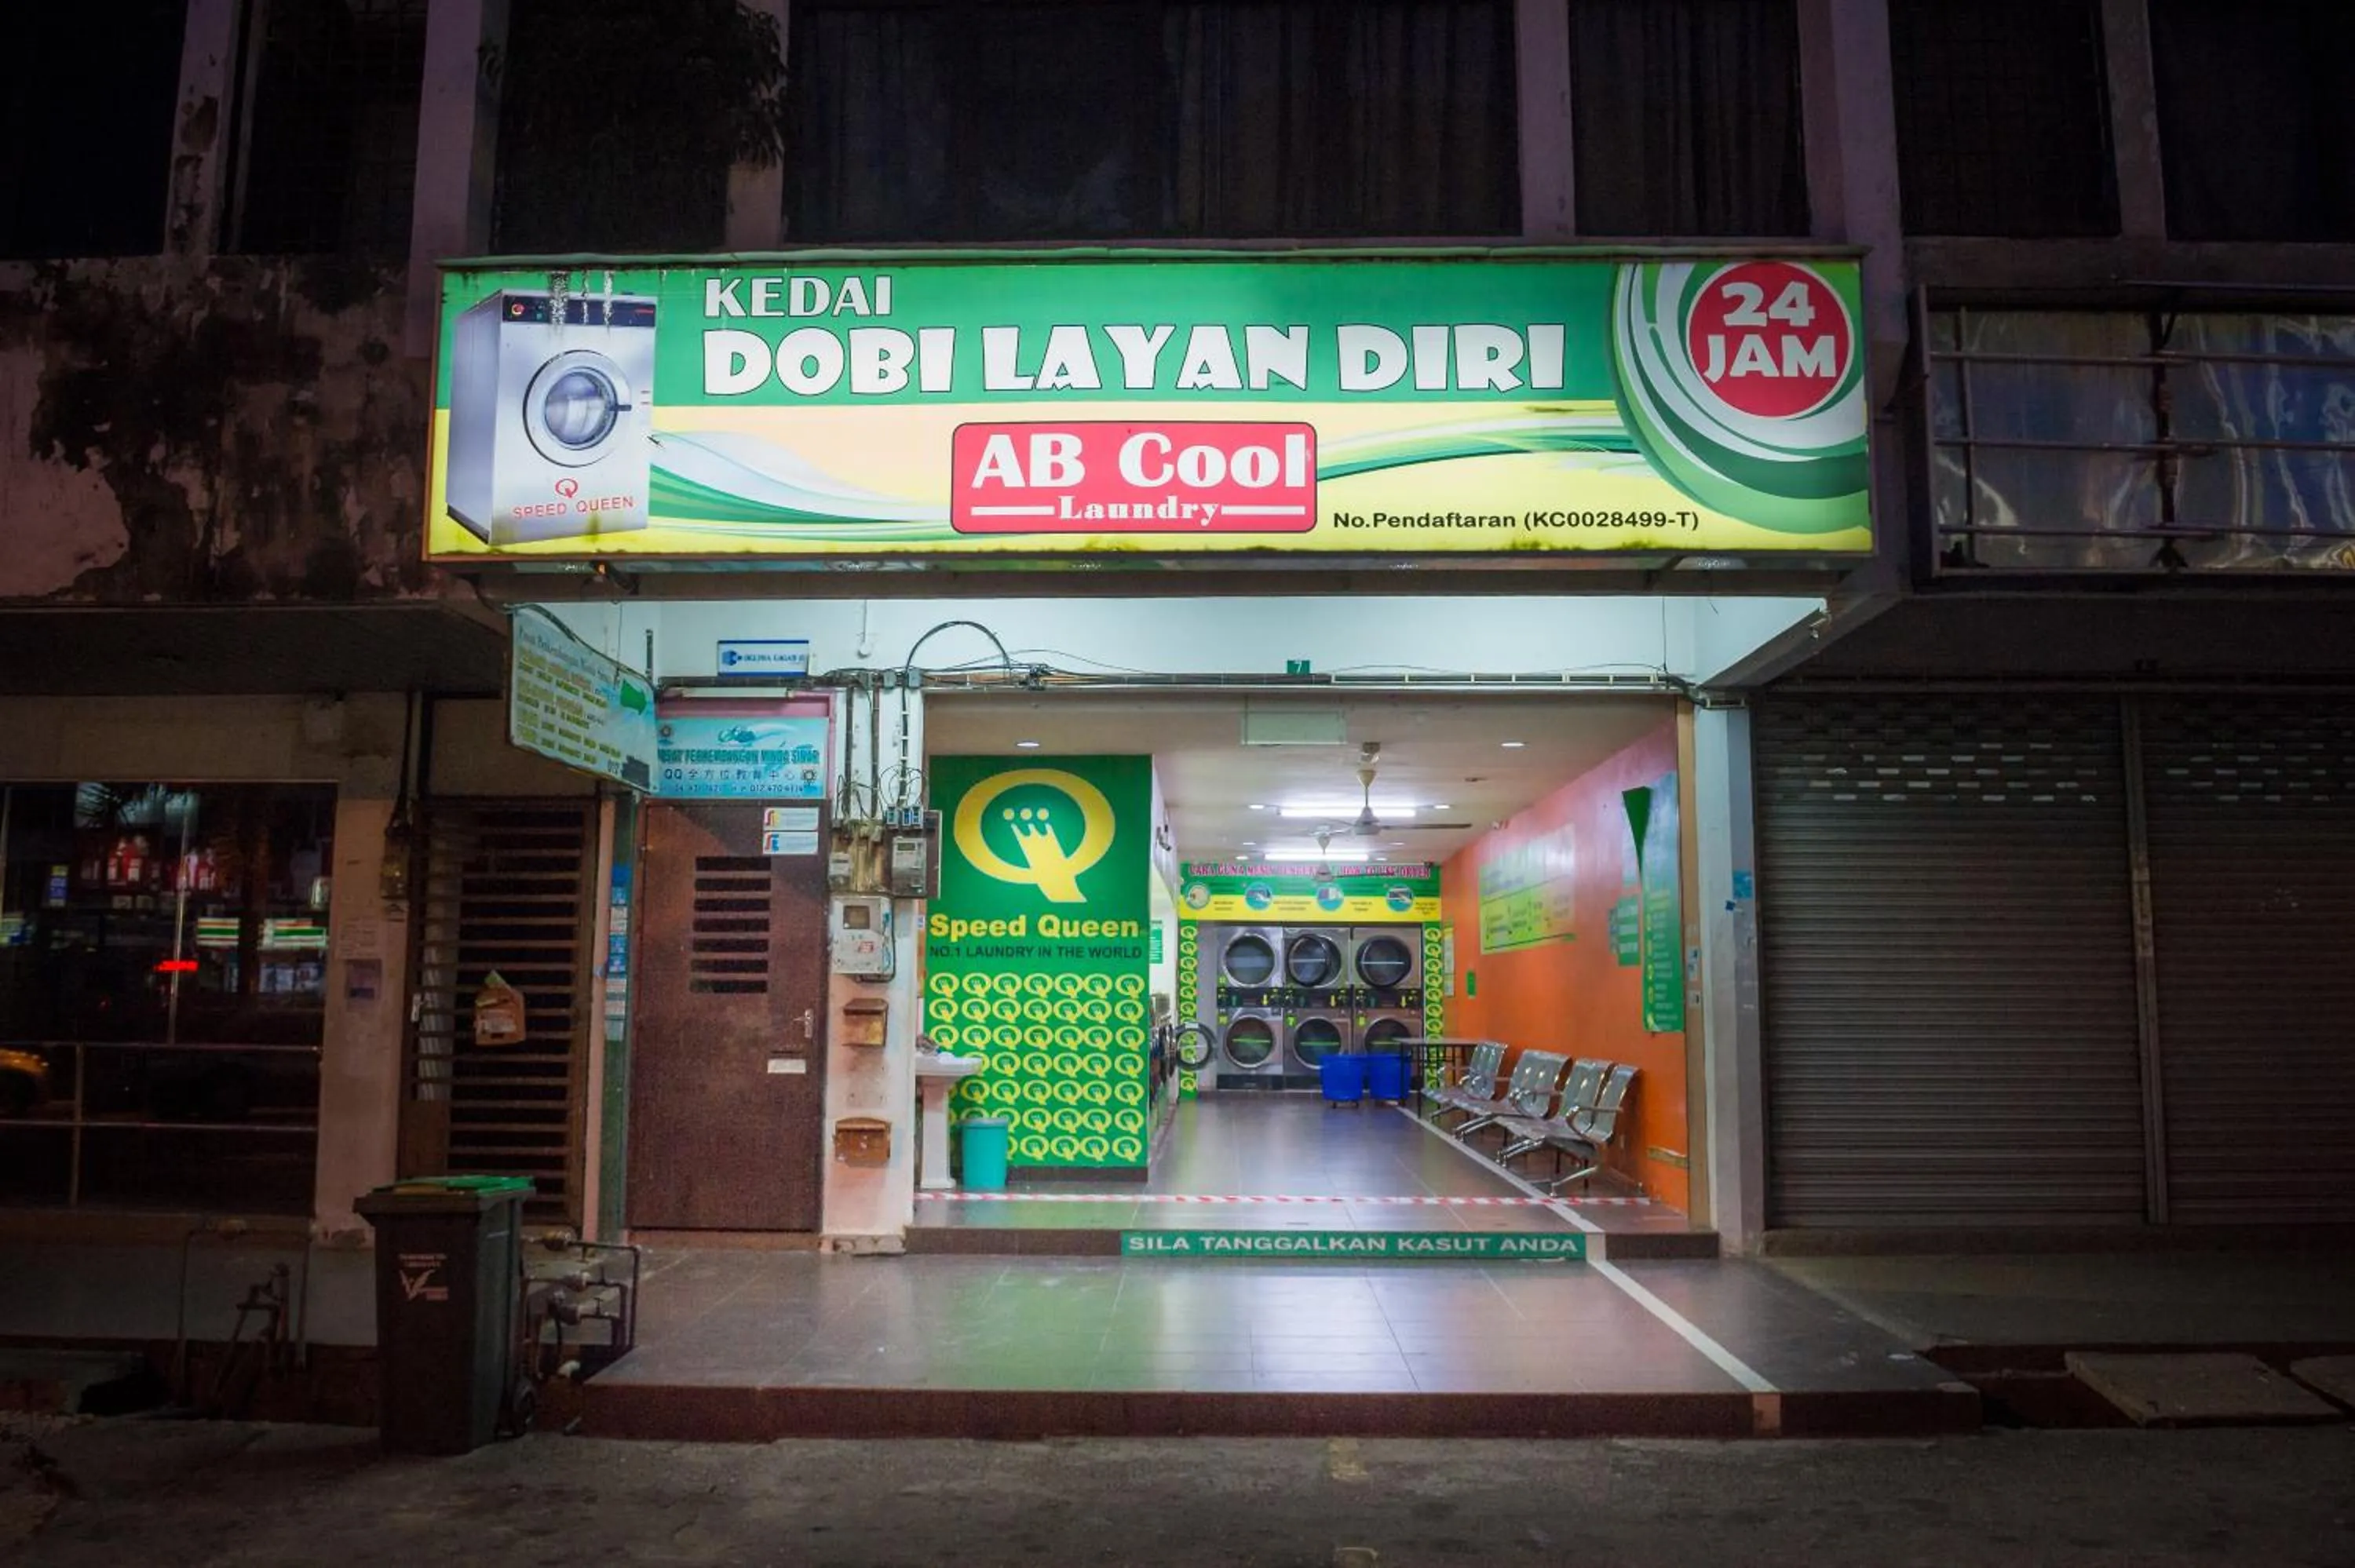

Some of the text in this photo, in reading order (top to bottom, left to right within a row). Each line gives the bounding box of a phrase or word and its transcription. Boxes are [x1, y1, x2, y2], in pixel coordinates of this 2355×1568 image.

[704, 276, 893, 318] KEDAI
[1721, 280, 1816, 328] 24
[703, 323, 1565, 396] DOBI LAYAN DIRI
[1703, 334, 1837, 383] JAM
[971, 432, 1306, 489] AB Cool
[513, 496, 634, 519] SPEED QUEEN
[1057, 495, 1220, 527] Laundry
[1333, 511, 1700, 531] No.Pendaftaran (KC0028499-T)
[929, 913, 1139, 943] Speed Queen
[929, 946, 961, 958] NO.1
[966, 946, 1034, 959] LAUNDRY
[1038, 946, 1053, 958] IN
[1057, 946, 1084, 959] THE
[1087, 946, 1142, 959] WORLD
[1129, 1236, 1578, 1253] SILA TANGGALKAN KASUT ANDA
